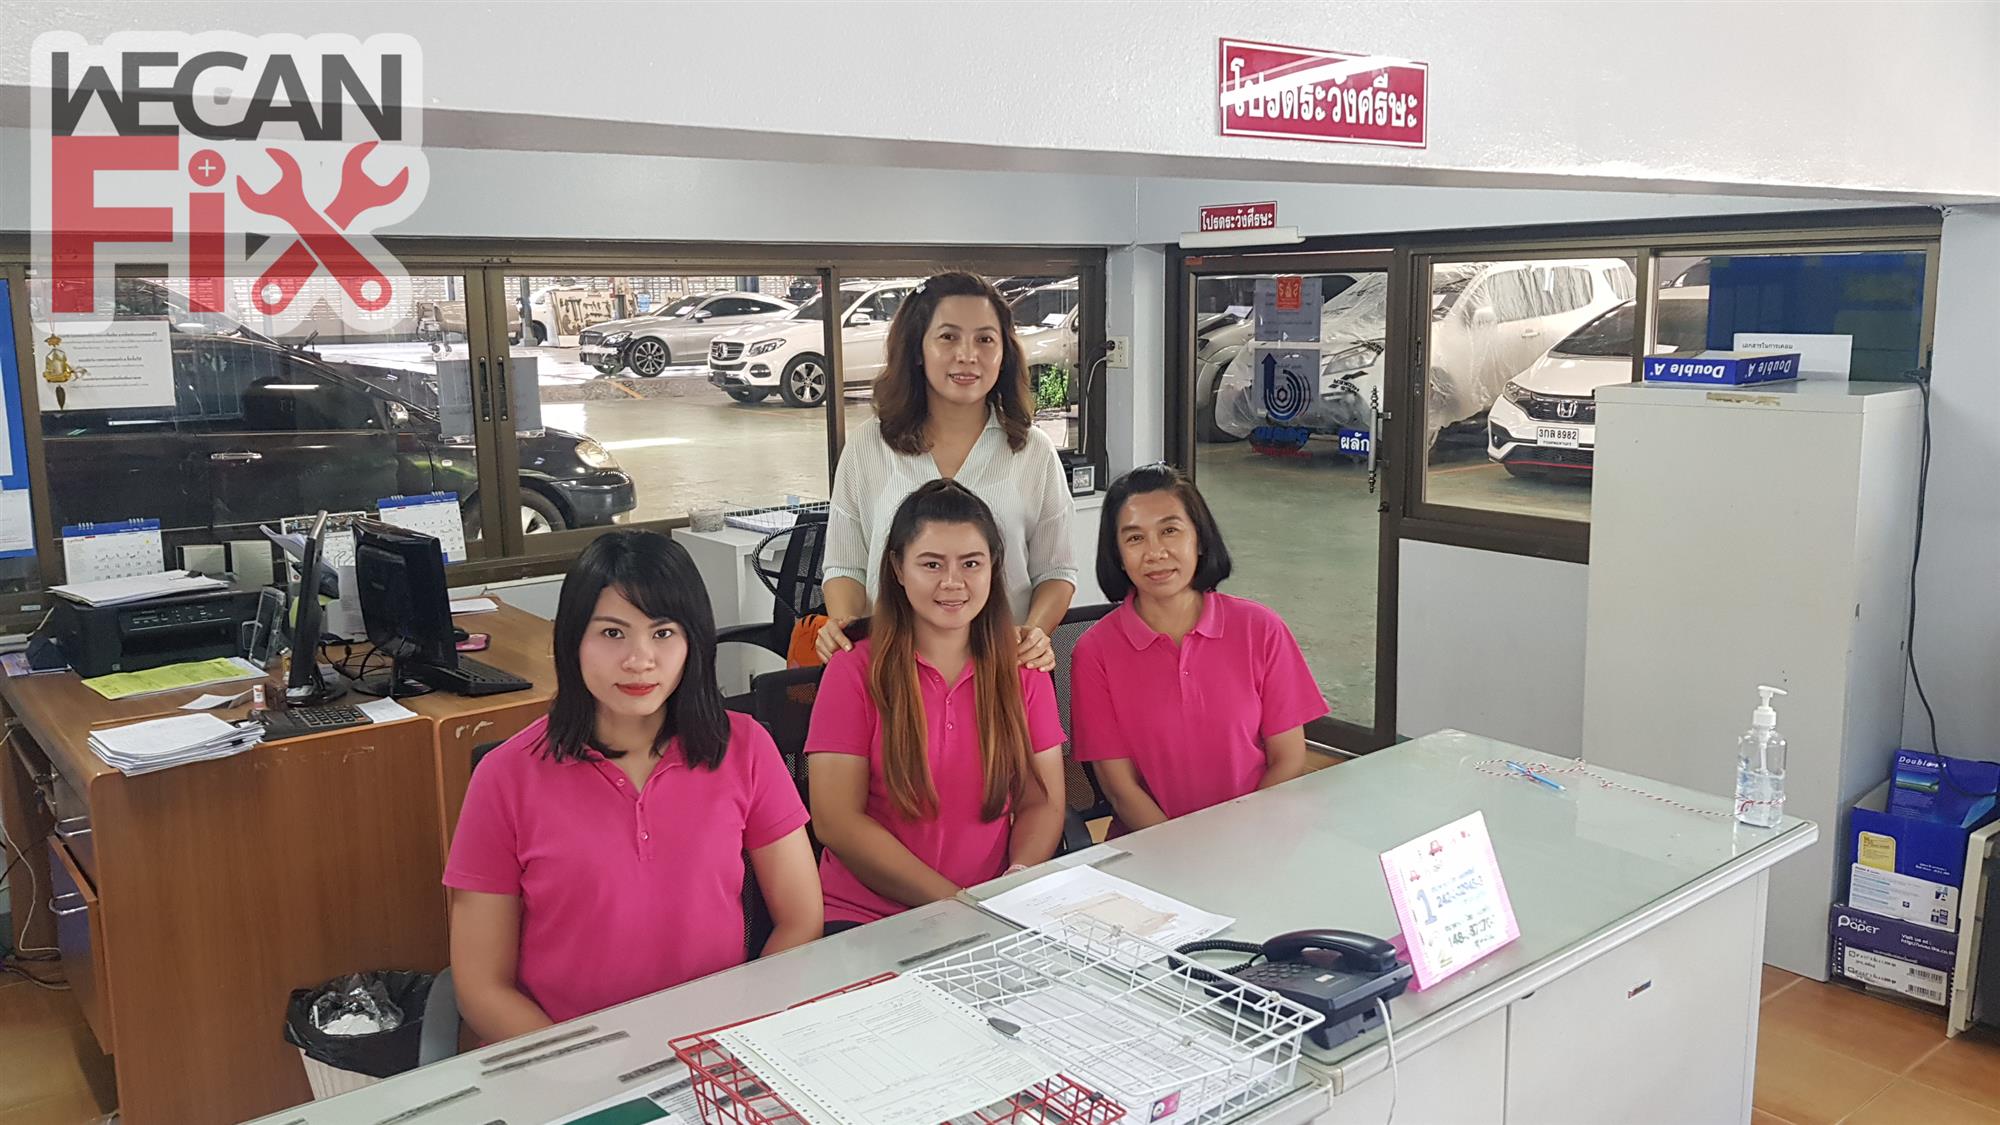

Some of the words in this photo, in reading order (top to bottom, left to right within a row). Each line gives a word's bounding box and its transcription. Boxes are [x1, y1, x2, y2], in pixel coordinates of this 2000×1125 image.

[1201, 207, 1273, 231] โปรดระวังศีรษะ
[1654, 363, 1666, 375] A
[1670, 363, 1725, 378] Double
[1748, 363, 1757, 377] A
[1758, 360, 1792, 375] Double
[1340, 431, 1370, 451] ผลัก
[1557, 430, 1577, 440] 8982
